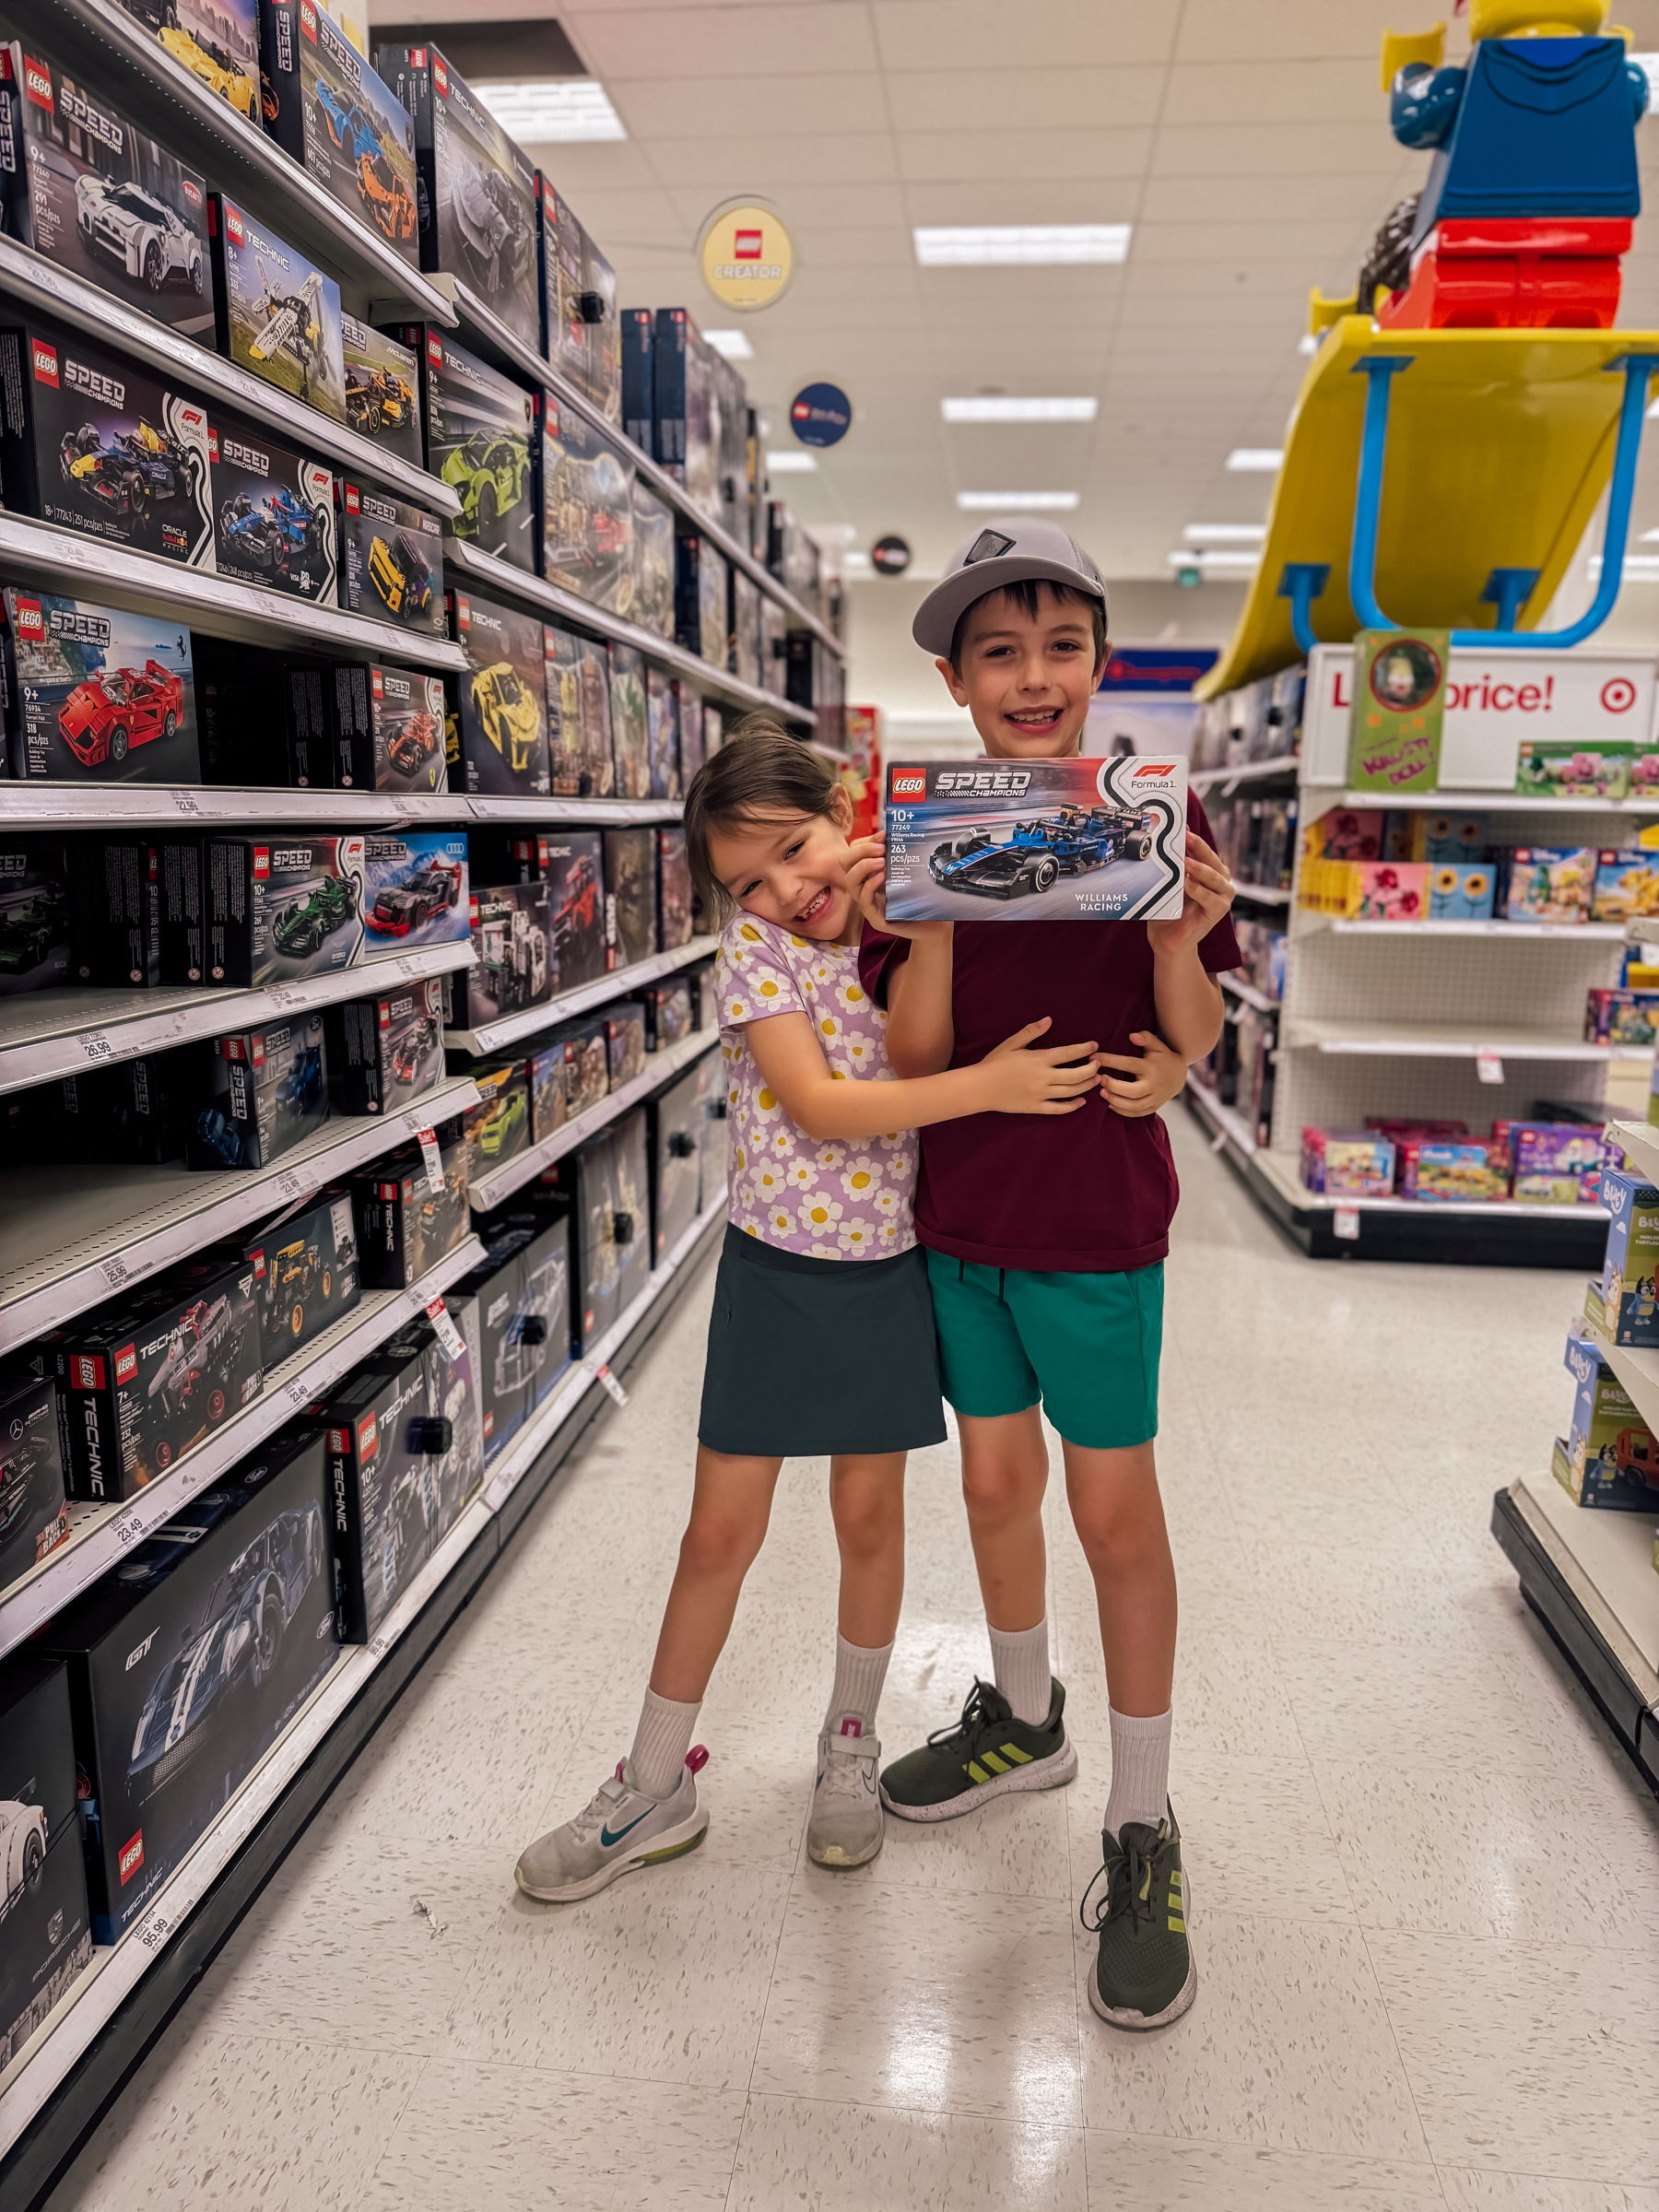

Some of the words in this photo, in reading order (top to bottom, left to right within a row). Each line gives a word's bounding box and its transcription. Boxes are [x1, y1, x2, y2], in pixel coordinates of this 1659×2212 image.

[301, 6, 316, 32] LEGO
[320, 18, 361, 85] SPEED
[415, 49, 423, 67] LEGO
[28, 70, 52, 99] LEGO
[435, 64, 447, 89] LEGO
[305, 101, 317, 124] 10+
[435, 97, 447, 115] 10+
[450, 82, 487, 132] TECHNIC
[60, 86, 124, 147] SPEED
[85, 123, 122, 156] CHAMPIONS
[30, 145, 46, 164] 9+
[32, 162, 51, 180] 77240
[34, 190, 47, 206] 291
[36, 204, 61, 225] pcs/pzs
[227, 216, 243, 238] LEGO
[228, 245, 238, 262] 8+
[246, 229, 290, 273] TECHNIC
[712, 264, 782, 280] CREATOR
[230, 277, 239, 291] 333
[386, 345, 415, 368] McLaren
[429, 342, 441, 360] LEGO
[35, 352, 57, 375] LEGO
[444, 350, 482, 386] TECHNIC
[65, 358, 125, 403] SPEED
[429, 371, 438, 384] 9+
[88, 389, 124, 411] CHAMPIONS
[223, 438, 270, 471] SPEED
[241, 461, 269, 478] CHAMPIONS
[347, 492, 359, 508] LEGO
[362, 495, 396, 521] SPEED
[44, 504, 53, 517] 18+
[55, 506, 73, 524] 77243
[75, 513, 84, 526] 251
[162, 524, 187, 538] ORACLE
[422, 518, 441, 536] NASCAR
[162, 542, 189, 555] RACING
[347, 537, 356, 549] 9+
[229, 565, 238, 577] 248
[18, 608, 43, 630] LEGO
[459, 606, 471, 622] LEGO
[471, 610, 502, 632] TECHNIC
[50, 608, 112, 639] SPEED
[73, 632, 111, 648] CHAMPIONS
[24, 687, 39, 702] 9+
[384, 677, 412, 694] SPEED
[25, 703, 41, 713] 76934
[27, 723, 38, 735] 318
[28, 735, 50, 747] pcs/pzs
[1133, 764, 1178, 778] F1
[892, 777, 925, 794] LEGO
[935, 771, 1032, 790] SPEED
[969, 788, 1027, 798] CHAMPIONS
[175, 800, 199, 811] 22.99
[890, 809, 915, 822] 10+
[273, 849, 312, 865] SPEED
[365, 841, 407, 856] SPEED
[890, 844, 907, 853] 263
[254, 853, 269, 871] LEGO
[890, 853, 921, 865] pcs/pzs
[287, 864, 312, 873] CHAMPIONS
[253, 884, 265, 896] 10+
[1075, 893, 1128, 902] WILLIAMS
[479, 900, 512, 915] TECHNIC
[1080, 903, 1123, 912] RACING
[253, 924, 269, 935] pcs/pzs
[332, 951, 347, 960] aramco
[391, 996, 413, 1016] SPEED
[76, 1034, 89, 1042] LEGO
[265, 1027, 290, 1052] SPEED
[84, 1041, 112, 1057] 26.99
[230, 1041, 240, 1059] LEGO
[253, 1046, 265, 1059] LEGO
[135, 1061, 149, 1114] SPEED
[232, 1065, 248, 1121] SPEED
[257, 1096, 265, 1108] 9+
[418, 1131, 432, 1145] Sale!
[282, 1179, 300, 1195] 23.49
[385, 1203, 394, 1252] TECHNIC
[107, 1265, 127, 1282] 25.99
[427, 1300, 441, 1318] Sale!
[139, 1317, 194, 1360] TECHNIC
[79, 1356, 97, 1388] LEGO
[117, 1353, 136, 1376] LEGO
[117, 1391, 129, 1404] 7+
[289, 1384, 308, 1403] 23.49
[379, 1374, 424, 1430] TECHNIC
[25, 1407, 50, 1427] PETRONAS
[121, 1428, 133, 1441] 232
[122, 1432, 141, 1452] pcs/pzs
[331, 1430, 343, 1453] LEGO
[360, 1422, 377, 1452] LEGO
[84, 1397, 105, 1498] TECHNIC
[360, 1464, 376, 1484] 10+
[333, 1458, 347, 1533] TECHNIC
[44, 1517, 61, 1538] PULL
[109, 1517, 123, 1530] LEGO
[117, 1518, 143, 1543] 23.49
[42, 1533, 62, 1555] BACK
[124, 1625, 162, 1672] GT
[120, 1840, 144, 1877] LEGO
[121, 1866, 164, 1924] TECHNIC
[132, 1923, 147, 1939] LEGO
[143, 1910, 157, 1925] 42154
[142, 1918, 169, 1947] 95.99
[32, 1918, 82, 1983] PORSCHE
